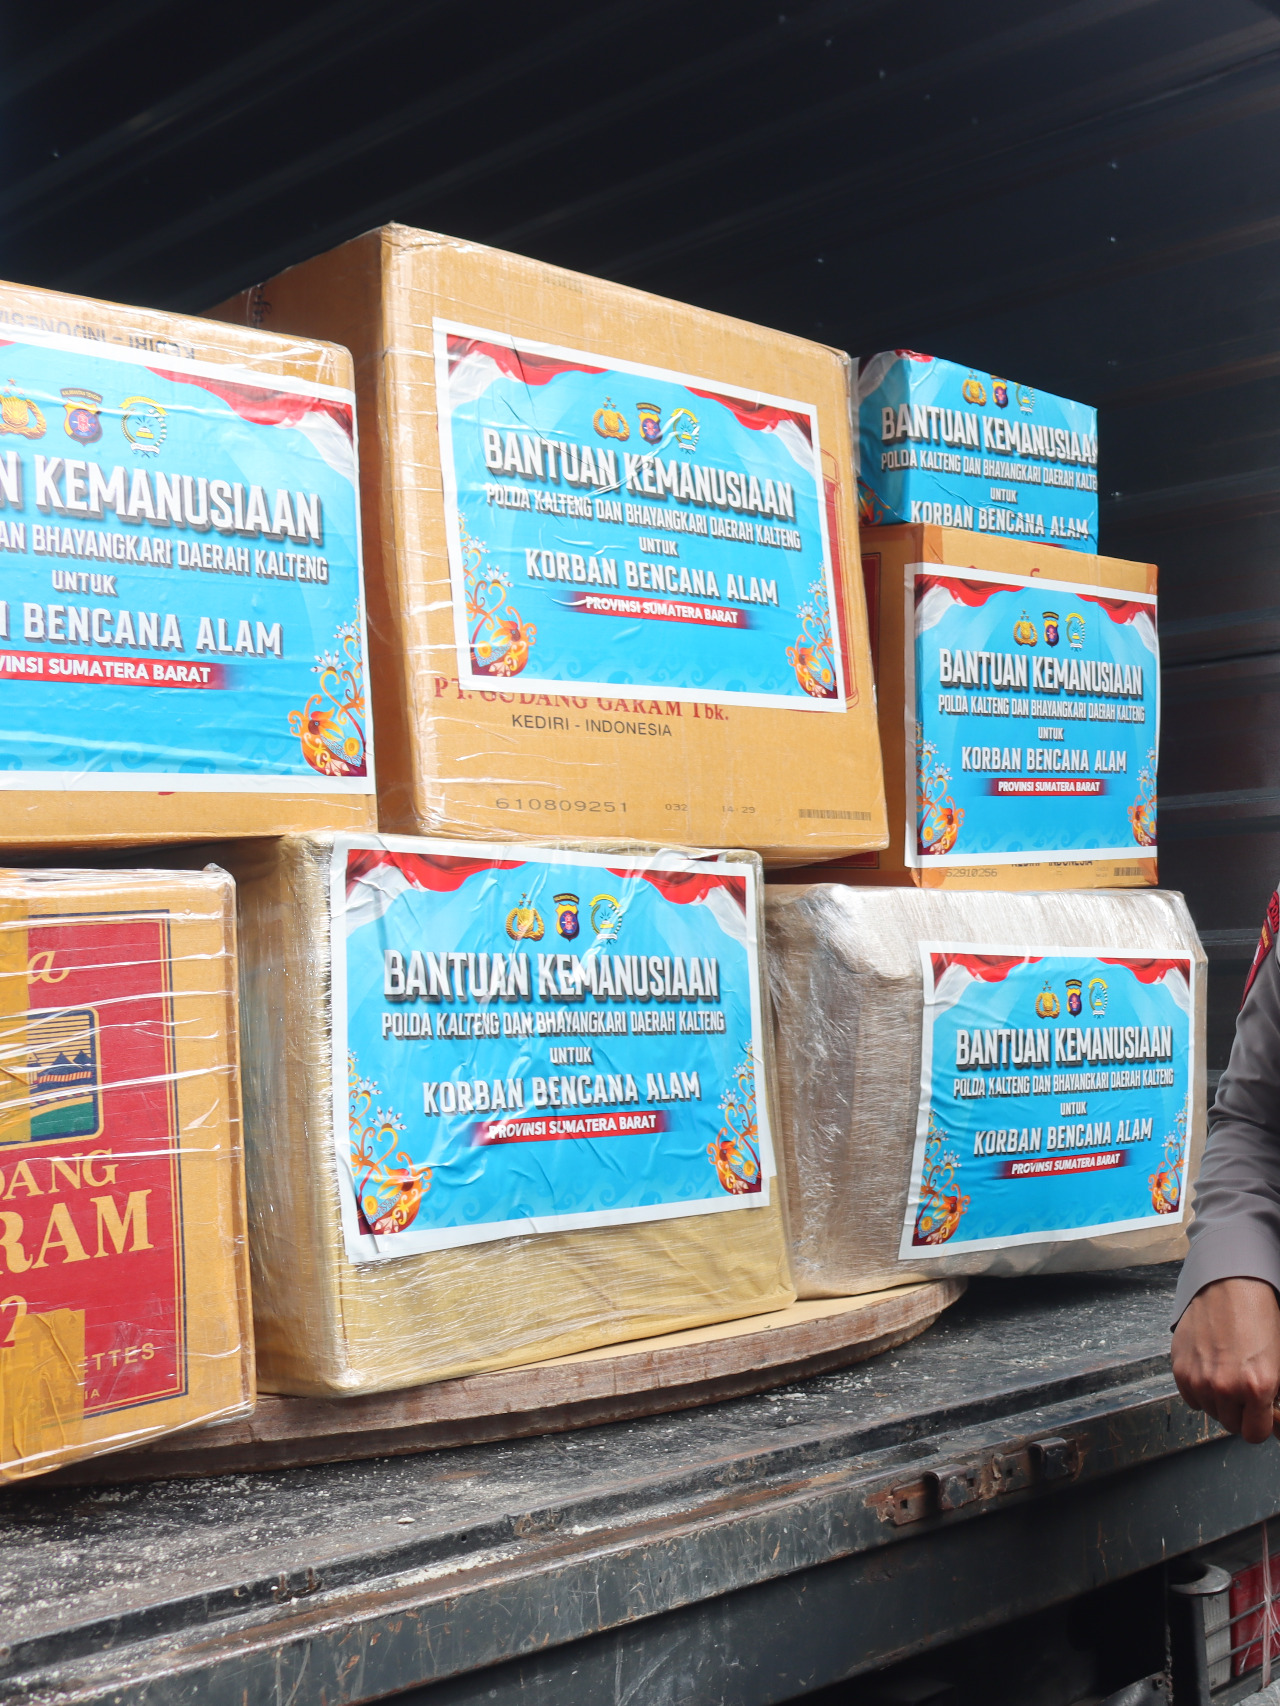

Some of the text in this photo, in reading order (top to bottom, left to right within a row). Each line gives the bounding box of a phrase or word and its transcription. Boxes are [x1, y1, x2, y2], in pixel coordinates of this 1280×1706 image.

[881, 403, 981, 449] BANTUAN
[483, 427, 796, 520] BANTUAN KEMANUSIAAN
[881, 449, 919, 471] POLDA
[920, 450, 962, 472] KALTENG
[963, 456, 982, 478] DAN
[983, 459, 1042, 485] BHAYANGKARI
[1043, 467, 1075, 488] DAERAH
[34, 454, 322, 544] KEMANUSIAAN
[989, 487, 1018, 502] UNTUK
[485, 482, 802, 550] POLDA KALTENG DAN BHAYANGKARI DAERAH KALTENG
[911, 500, 1090, 540] KORBAN BENCANA ALAM
[32, 524, 172, 566] BHAYANGKARI
[178, 540, 250, 575] DAERAH
[255, 549, 329, 583] KALTENG
[639, 537, 679, 556] UNTUK
[52, 570, 118, 596] UNTUK
[525, 549, 779, 606] KORBAN BENCANA ALAM
[584, 596, 739, 624] PROVINSI SUMATERA BARAT
[23, 602, 184, 651] BENCANA
[196, 617, 283, 658] ALAM
[49, 658, 150, 681] SUMATERA
[153, 661, 211, 684] BARAT
[939, 648, 1144, 698] BANTUAN KEMANUSIAAN
[938, 694, 1146, 723] POLDA KALTENG DAN BHAYANGKARI DAERAH KALTENG
[512, 714, 570, 730] KEDIRI
[585, 718, 673, 737] INDONESIA
[1037, 727, 1065, 740] UNTUK
[961, 746, 1127, 773] KORBAN BENCANA ALAM
[998, 781, 1100, 793] PROVINSI SUMATERA BARAT
[495, 798, 628, 814] 610809251
[384, 949, 720, 1001] BANTUAN KEMANUSIAAN
[382, 1010, 726, 1039] POLDA KALTENG DAN BHAYANGKARI DAERAH KALTENG
[549, 1046, 593, 1065] UNTUK
[956, 1025, 1173, 1069] BANTUAN KEMANUSIAAN
[422, 1071, 702, 1117] KORBAN BENCANA ALAM
[953, 1068, 1175, 1099] POLDA KALTENG DAN BHAYANGKARI DAERAH KALTENG
[1060, 1101, 1087, 1117] UNTUK
[488, 1114, 657, 1140] PROVINSI SUMATERA BARAT
[973, 1117, 1153, 1157] KORBAN BENCANA ALAM
[1011, 1153, 1121, 1175] PROVINSI SUMATERA BARAT
